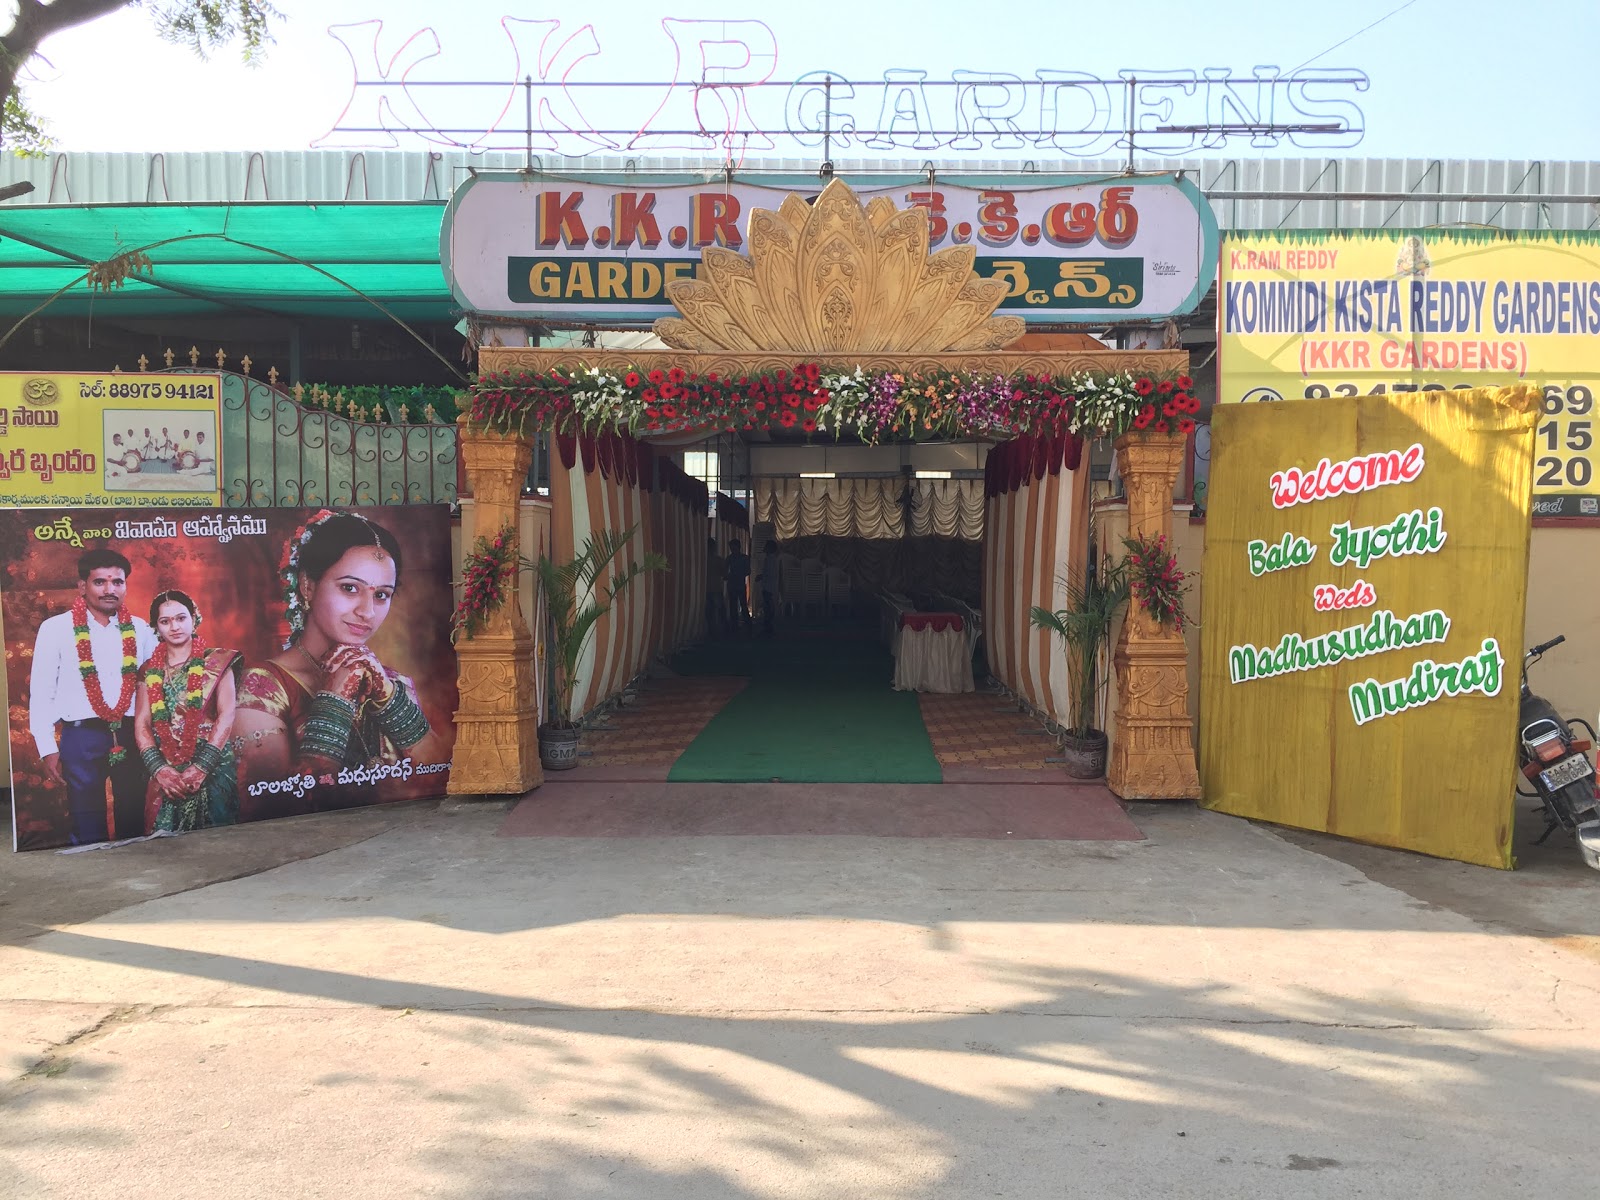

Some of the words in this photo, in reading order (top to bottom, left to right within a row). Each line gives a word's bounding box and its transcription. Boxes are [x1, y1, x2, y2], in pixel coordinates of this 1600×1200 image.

[785, 66, 1371, 151] GARDENS
[535, 191, 743, 250] K.K.R
[1230, 250, 1281, 270] K.RAM
[1286, 249, 1338, 270] REDDY
[528, 261, 703, 300] GARDE
[1225, 280, 1327, 334] KOMMIDI
[1334, 280, 1402, 334] KISTA
[1410, 280, 1486, 334] REDDY
[1493, 280, 1600, 335] GARDENS
[1299, 341, 1370, 377] (KKR
[1380, 341, 1528, 377] GARDENS)
[109, 383, 162, 399] 88975
[164, 384, 215, 400] 94121
[12, 405, 60, 427] సాయి
[30, 448, 96, 483] బృందం
[1271, 445, 1424, 507] Welcome
[82, 527, 112, 539] వారి
[1248, 533, 1317, 576] Bala
[1329, 507, 1447, 568] Jyothi
[1314, 580, 1376, 611] Weds
[1230, 610, 1450, 684] Madhusudhan
[1349, 637, 1504, 726] Mudiraj
